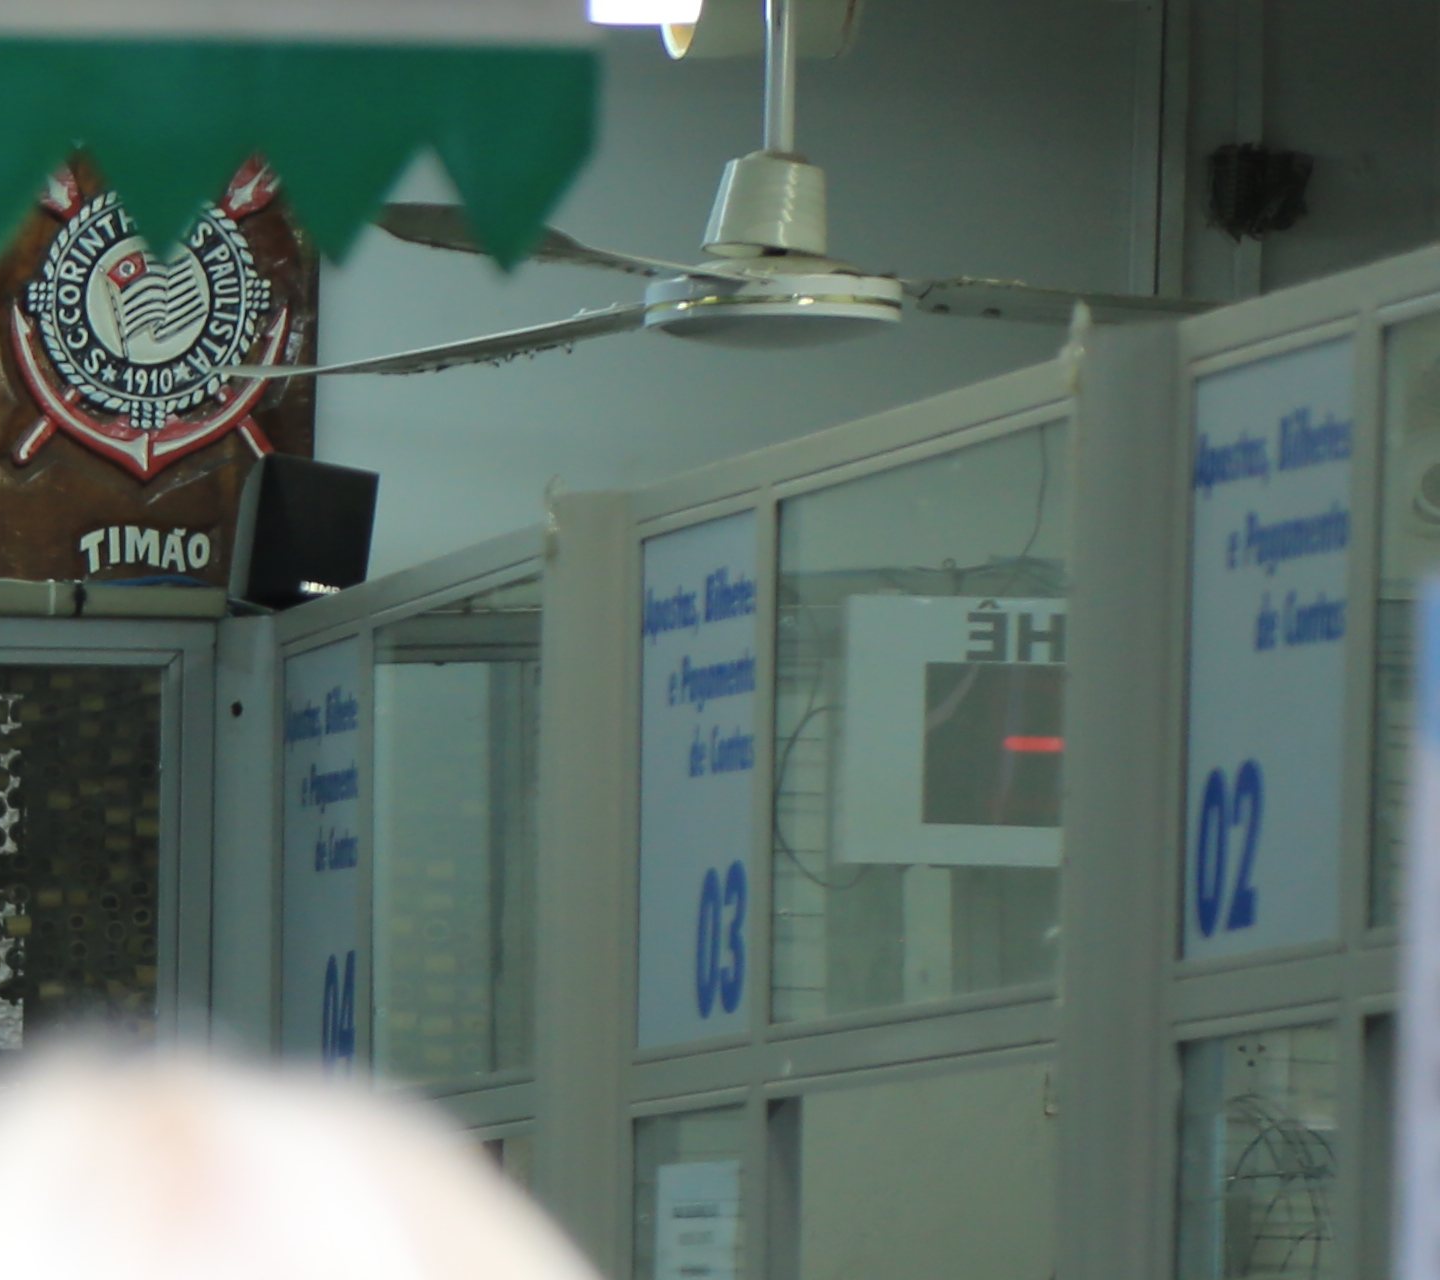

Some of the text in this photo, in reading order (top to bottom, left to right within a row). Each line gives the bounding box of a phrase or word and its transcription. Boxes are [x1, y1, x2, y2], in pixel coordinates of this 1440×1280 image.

[186, 243, 241, 375] PAULISTA
[123, 367, 173, 394] 1910
[80, 525, 211, 573] TIMÃO
[1196, 757, 1265, 938] 02
[695, 860, 748, 1019] 03
